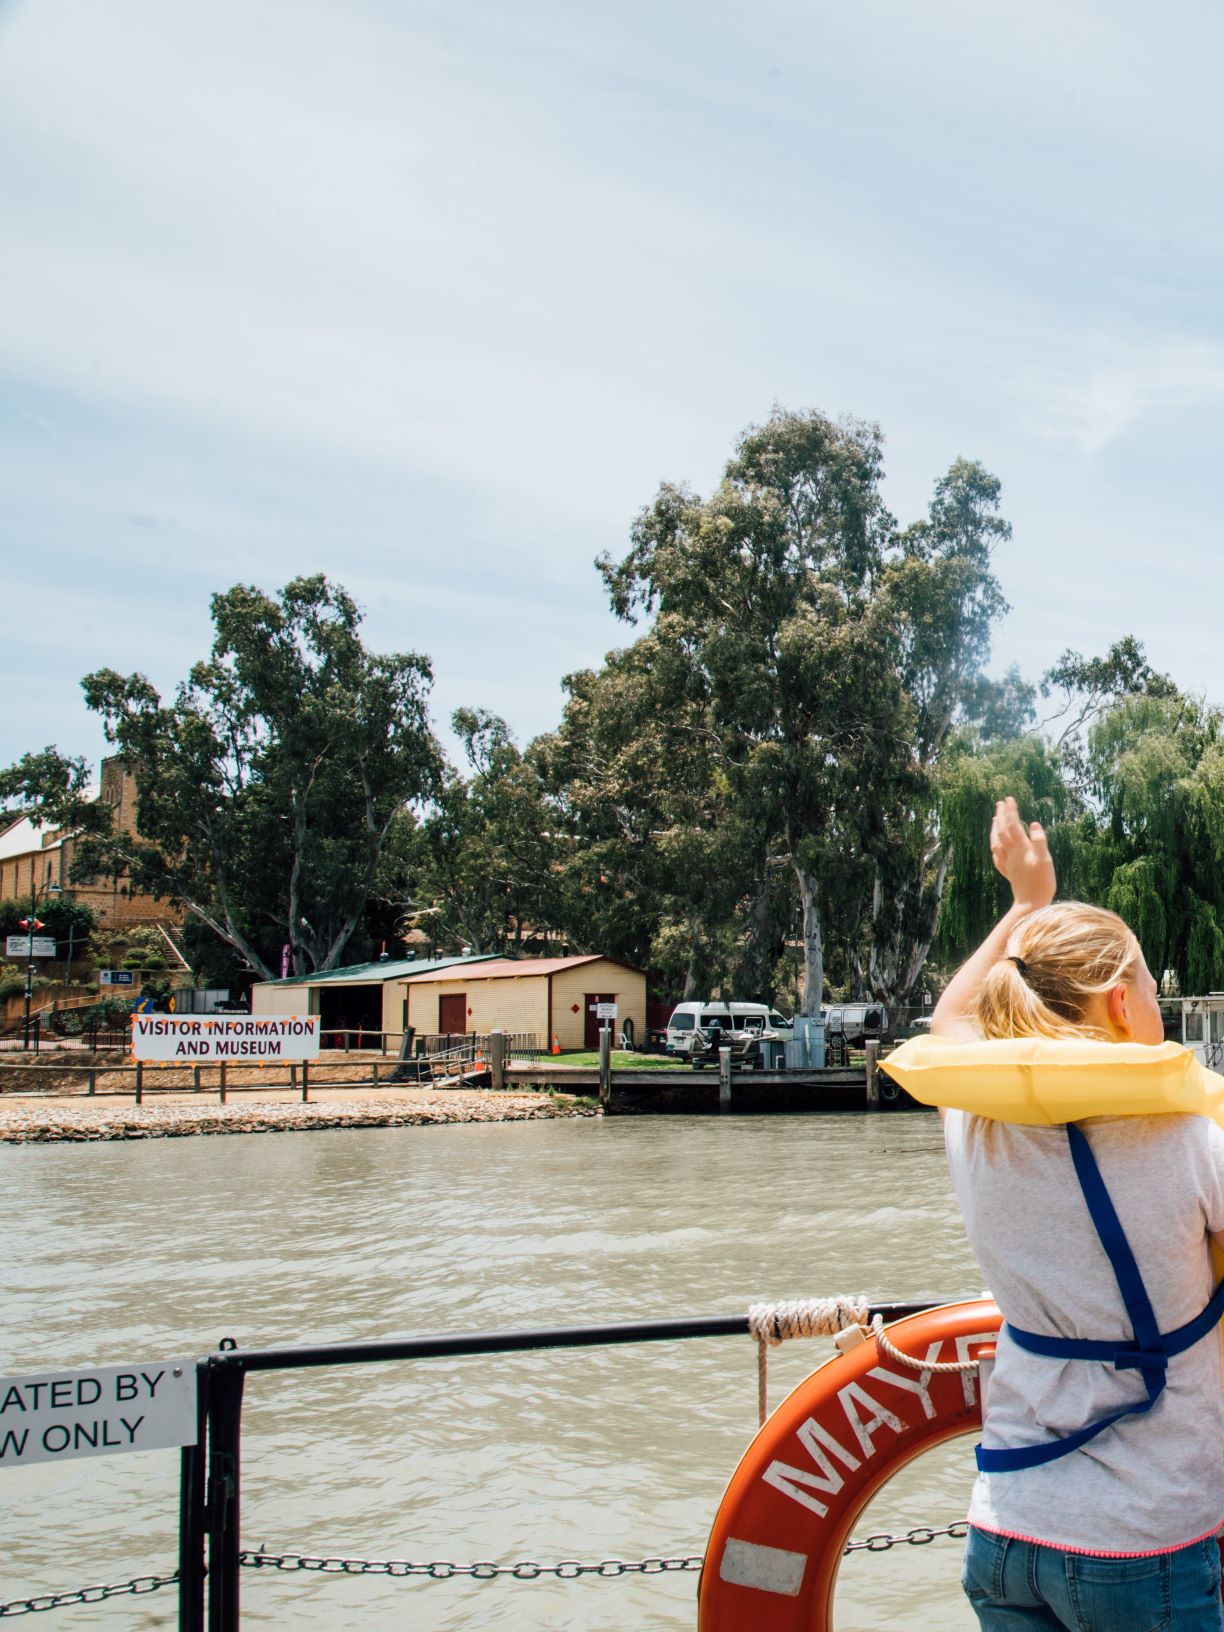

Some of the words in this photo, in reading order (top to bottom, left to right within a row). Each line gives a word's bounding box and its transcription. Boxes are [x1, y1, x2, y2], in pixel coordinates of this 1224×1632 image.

[138, 1020, 201, 1035] VISITOR
[208, 1020, 314, 1035] INFORMATION
[176, 1041, 209, 1055] AND
[216, 1041, 281, 1054] MUSEUM
[116, 1371, 166, 1401] BY
[42, 1416, 145, 1452] ONLY
